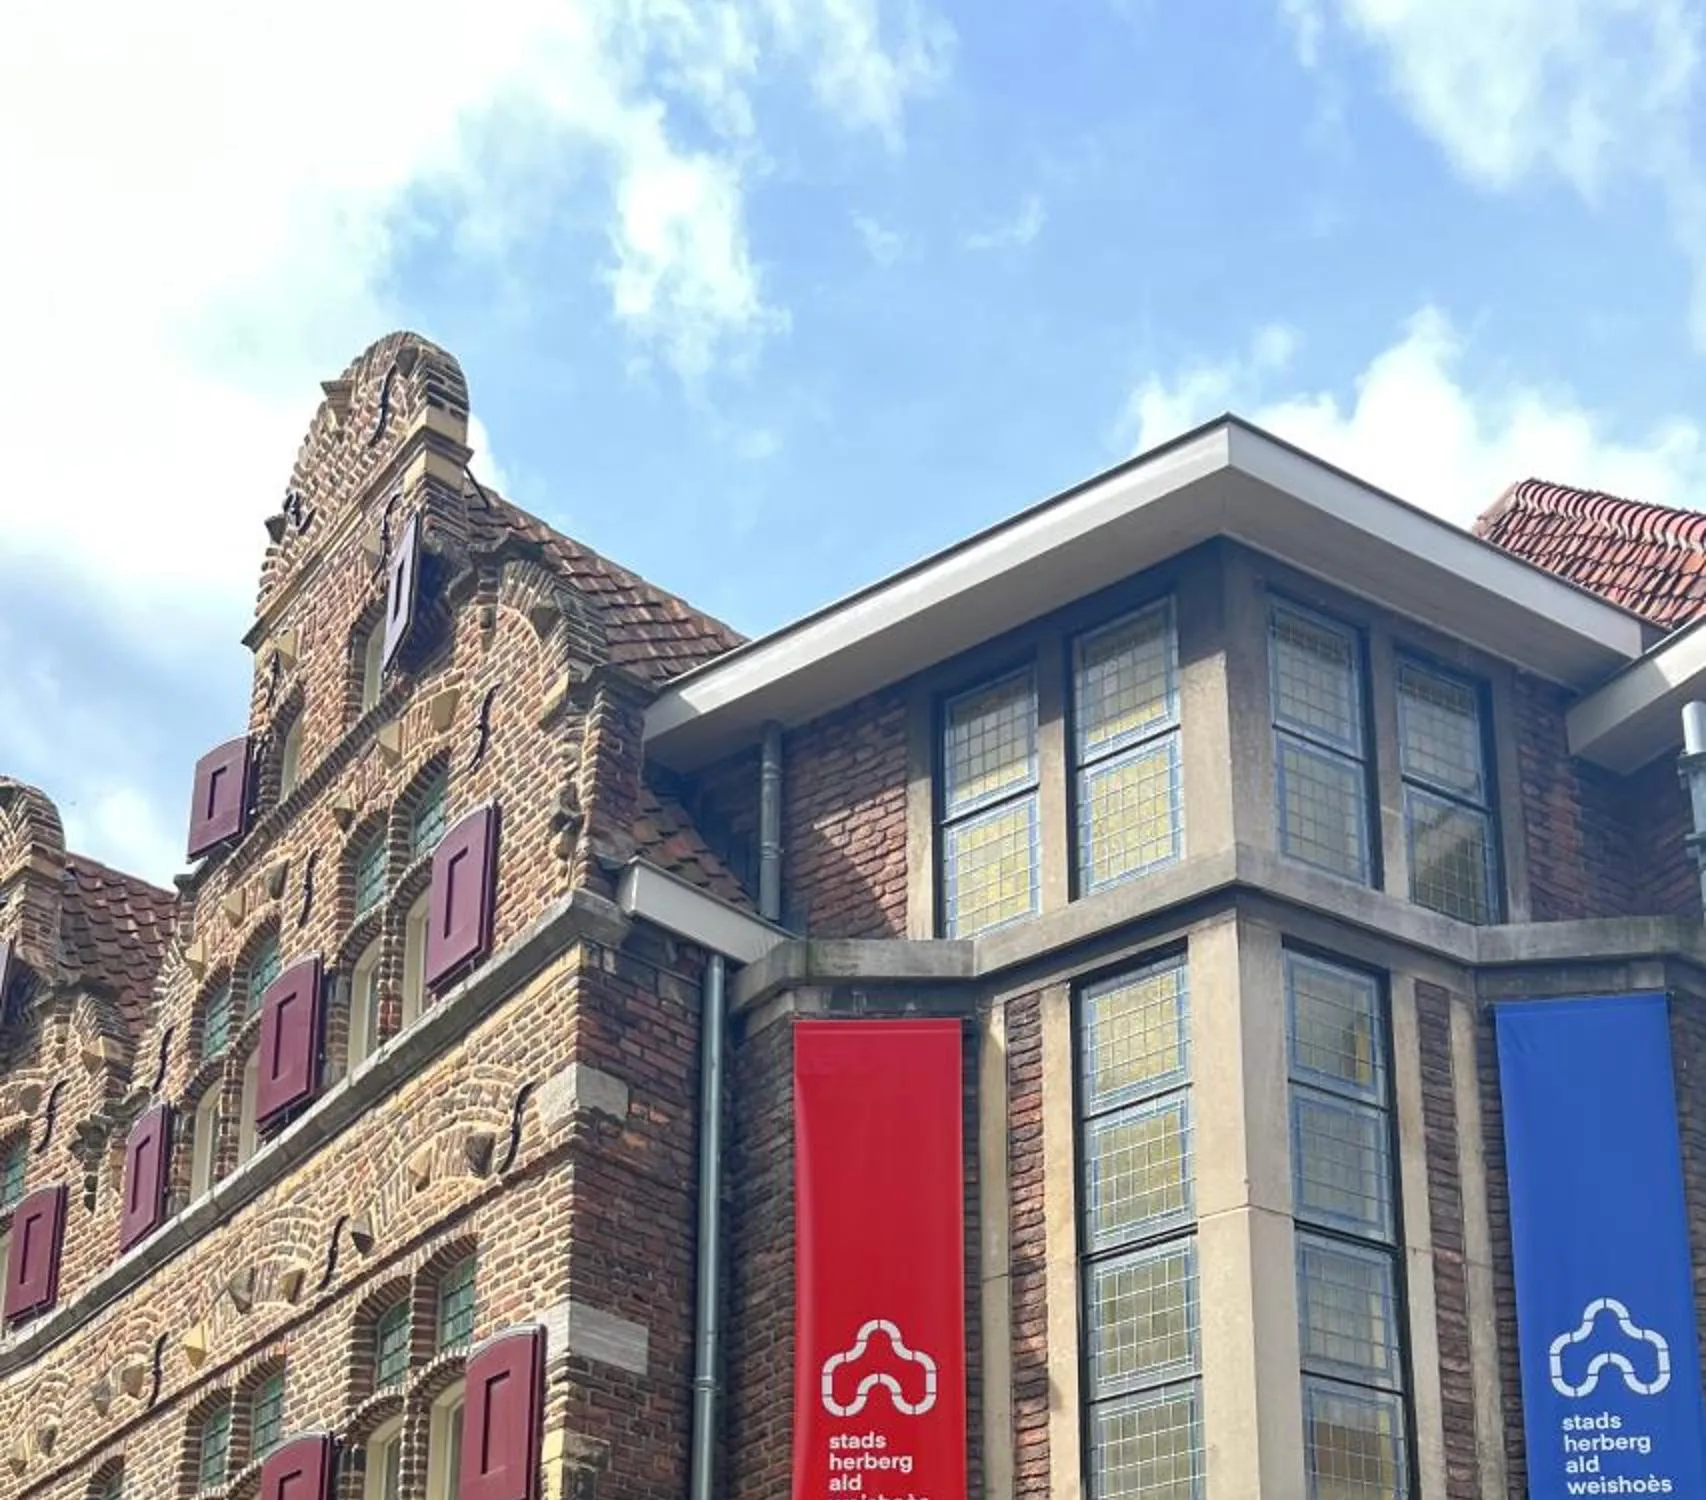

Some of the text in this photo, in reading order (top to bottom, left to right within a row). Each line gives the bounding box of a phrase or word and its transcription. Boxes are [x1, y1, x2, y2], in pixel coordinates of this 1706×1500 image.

[1562, 1411, 1622, 1431] stads
[829, 1431, 887, 1450] stads
[1564, 1434, 1651, 1454] herberg
[829, 1452, 913, 1473] herberg
[1565, 1455, 1600, 1474] ald
[829, 1474, 862, 1491] ald
[1567, 1474, 1672, 1495] weishoès
